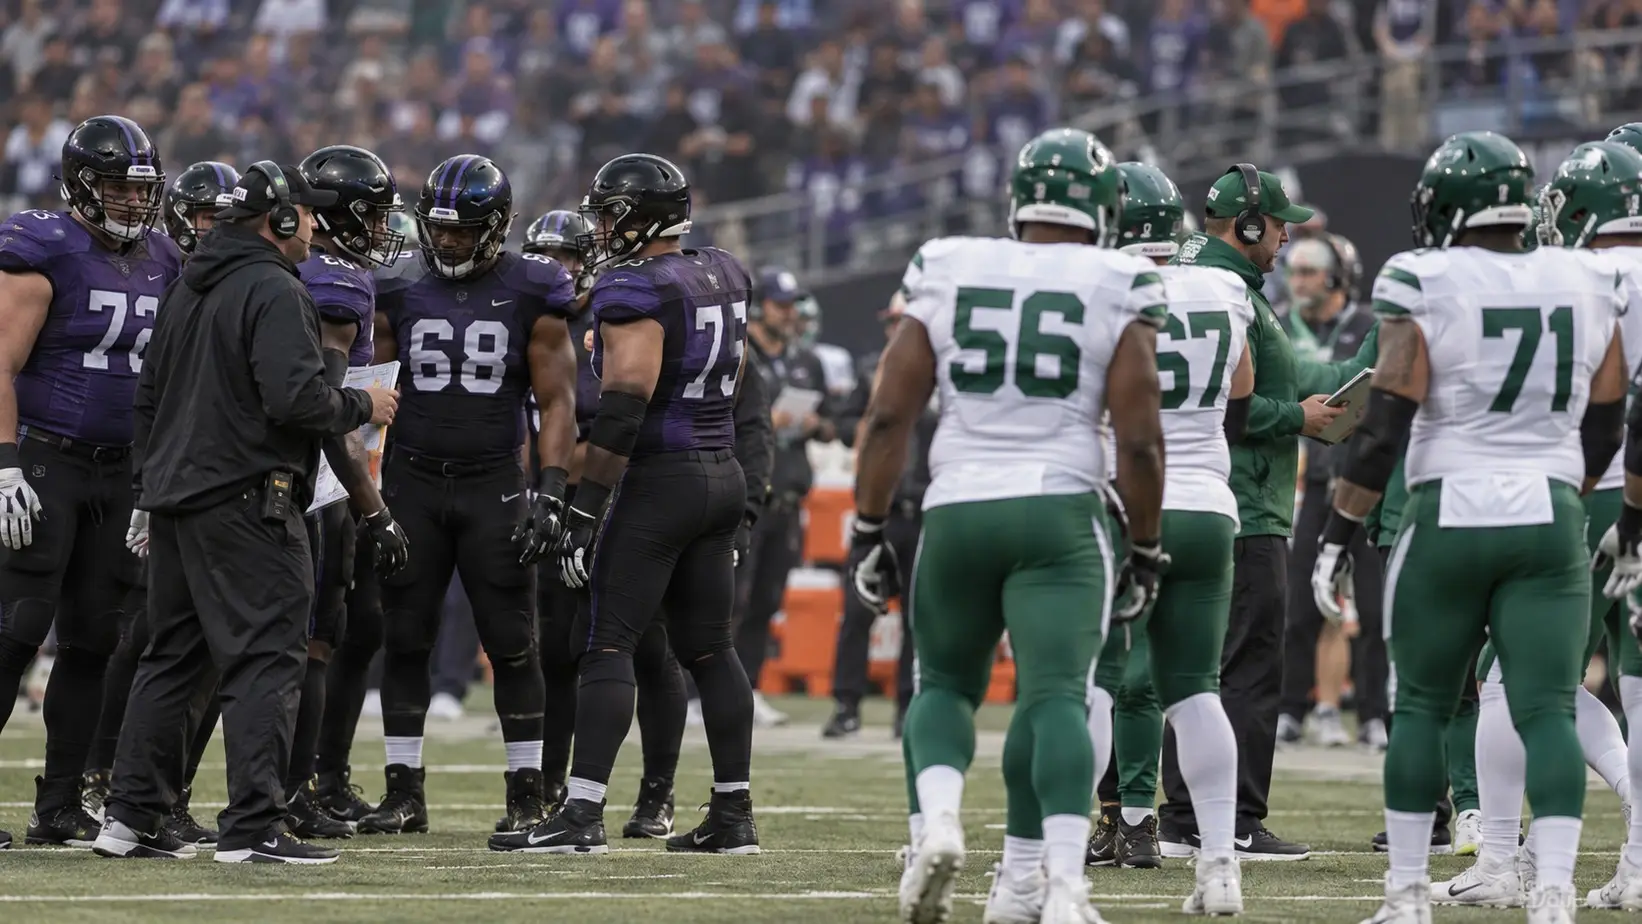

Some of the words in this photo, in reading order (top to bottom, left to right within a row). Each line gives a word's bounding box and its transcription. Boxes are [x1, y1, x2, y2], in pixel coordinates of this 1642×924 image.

[410, 318, 508, 393] 68
[682, 300, 747, 398] 75
[950, 287, 1085, 399] 56
[1156, 310, 1231, 409] 67
[1482, 306, 1574, 412] 71
